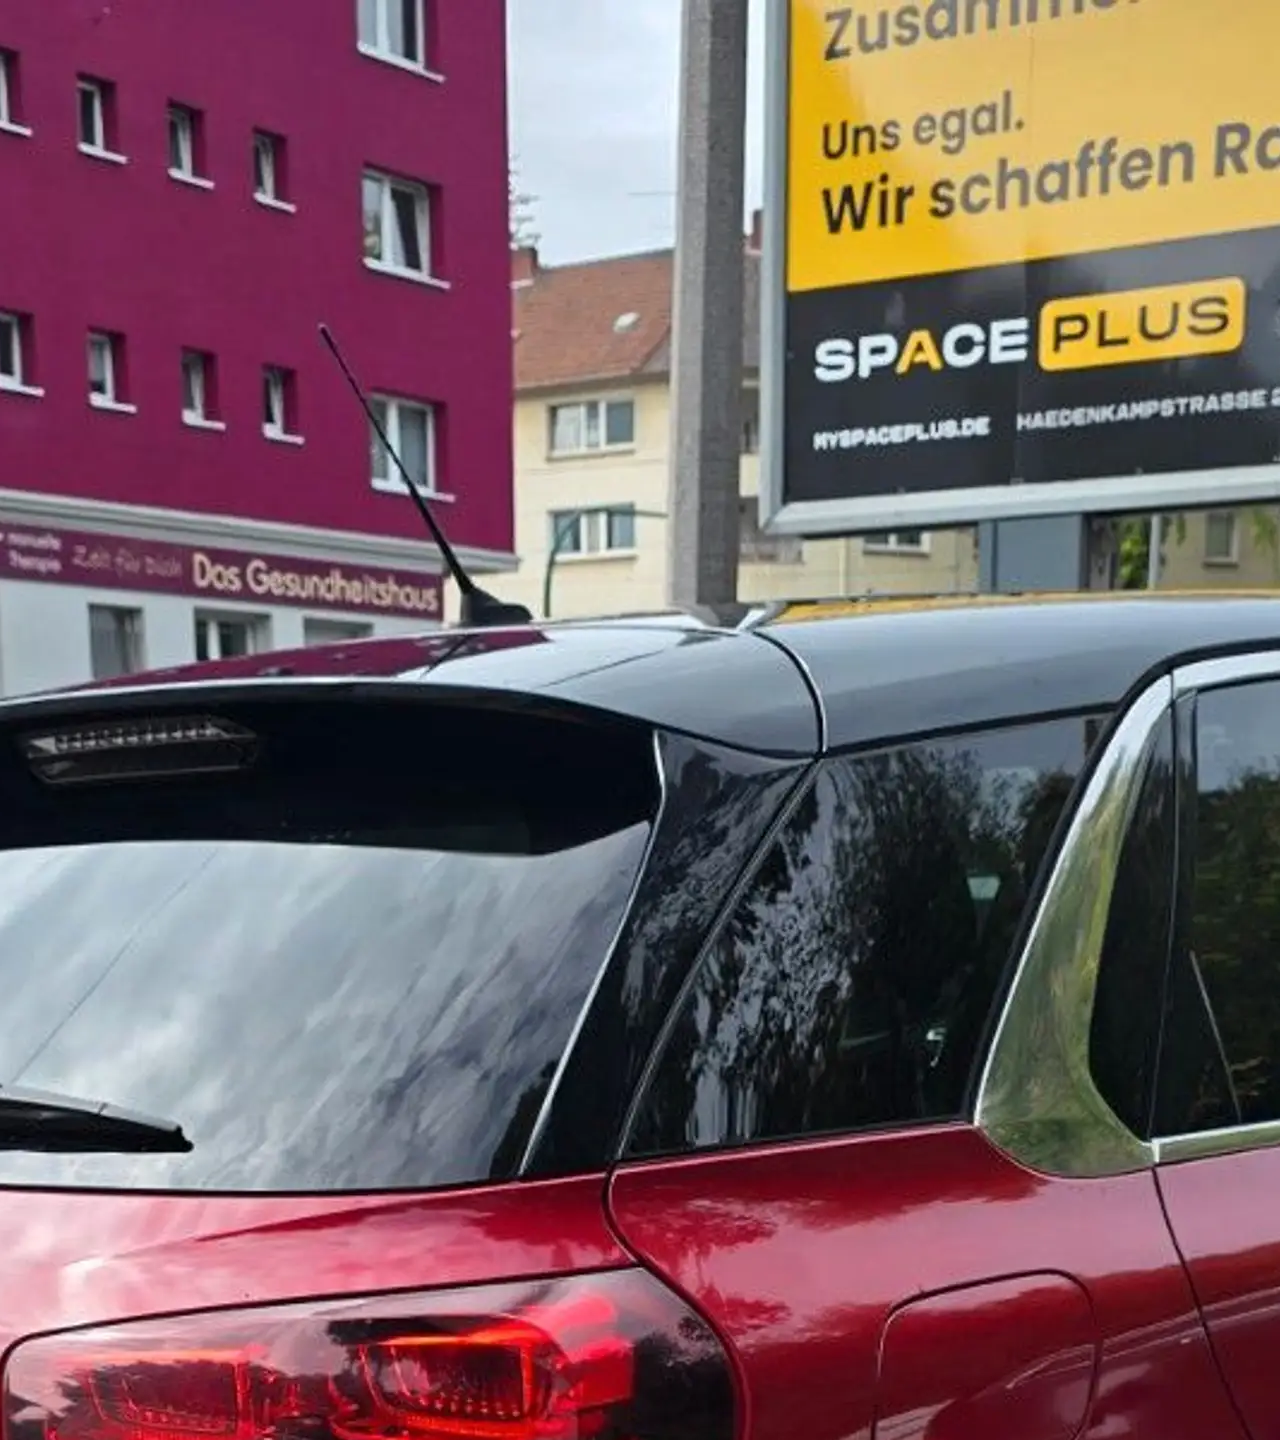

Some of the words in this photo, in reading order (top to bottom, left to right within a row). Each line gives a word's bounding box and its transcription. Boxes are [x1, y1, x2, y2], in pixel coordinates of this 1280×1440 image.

[823, 120, 900, 160] Uns
[912, 89, 1025, 155] egal.
[822, 172, 914, 234] Wir
[929, 137, 1196, 219] schaffen
[814, 316, 1030, 382] SPACE
[1052, 297, 1230, 352] PLUS
[813, 416, 991, 451] MYSPACEPLUS.DE
[1016, 388, 1268, 431] HAEDENKAMPSTRASSE
[192, 552, 242, 592] Das
[245, 558, 438, 612] Gesundheitshaus
